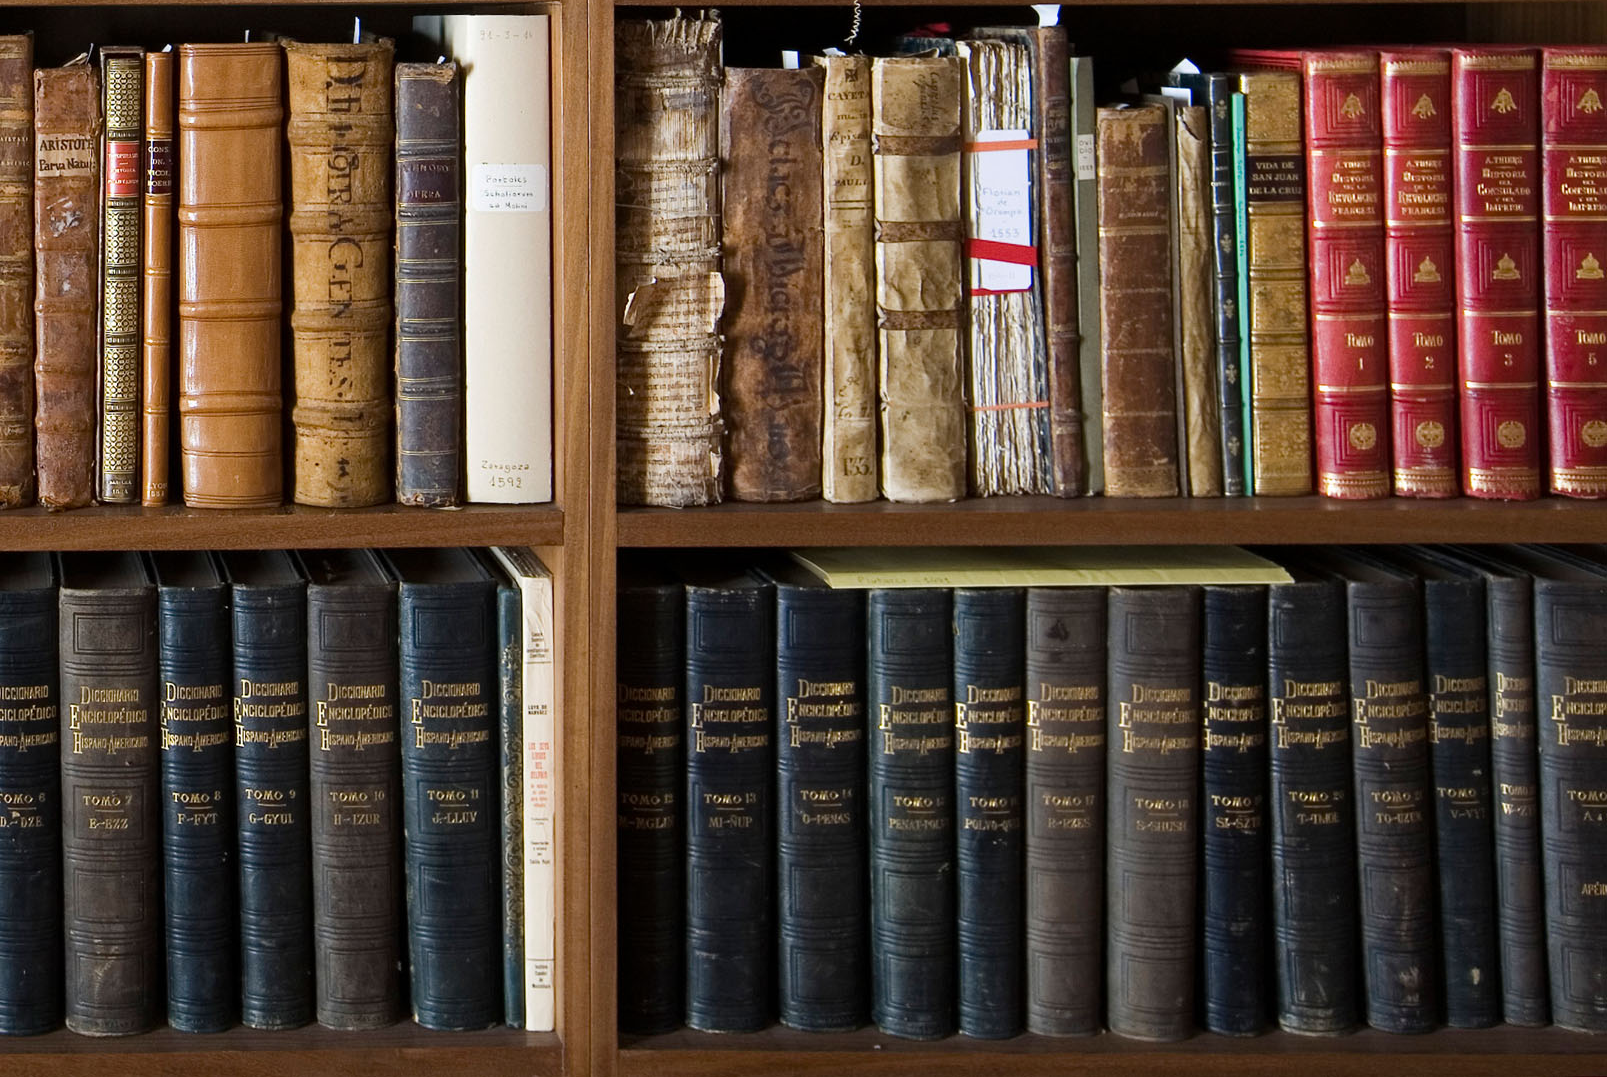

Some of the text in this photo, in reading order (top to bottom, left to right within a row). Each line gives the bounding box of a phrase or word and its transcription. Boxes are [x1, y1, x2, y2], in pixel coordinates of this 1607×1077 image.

[1255, 161, 1295, 171] VIDA DE
[1252, 173, 1299, 183] SAN JUAN
[1249, 186, 1261, 196] DE
[1262, 186, 1275, 196] LA
[1344, 332, 1374, 348] TOMO
[1412, 332, 1443, 348] TOMO
[1491, 330, 1523, 346] TOMO
[1575, 329, 1606, 345] TOMO
[1425, 356, 1434, 369] 2
[1504, 353, 1513, 367] 3
[1588, 353, 1597, 366] 5
[422, 680, 480, 700] DICCIONARIO
[69, 704, 148, 730] ENCICLOPÉDICO
[83, 795, 121, 807] TOMO
[173, 791, 222, 803] TOMO 8
[245, 789, 296, 801] TOMO 9
[330, 791, 384, 802] TOMO 10
[427, 790, 465, 801] TOMO
[704, 793, 742, 805] TOMO
[801, 790, 840, 802] TOMO
[1042, 795, 1082, 807] TOMO
